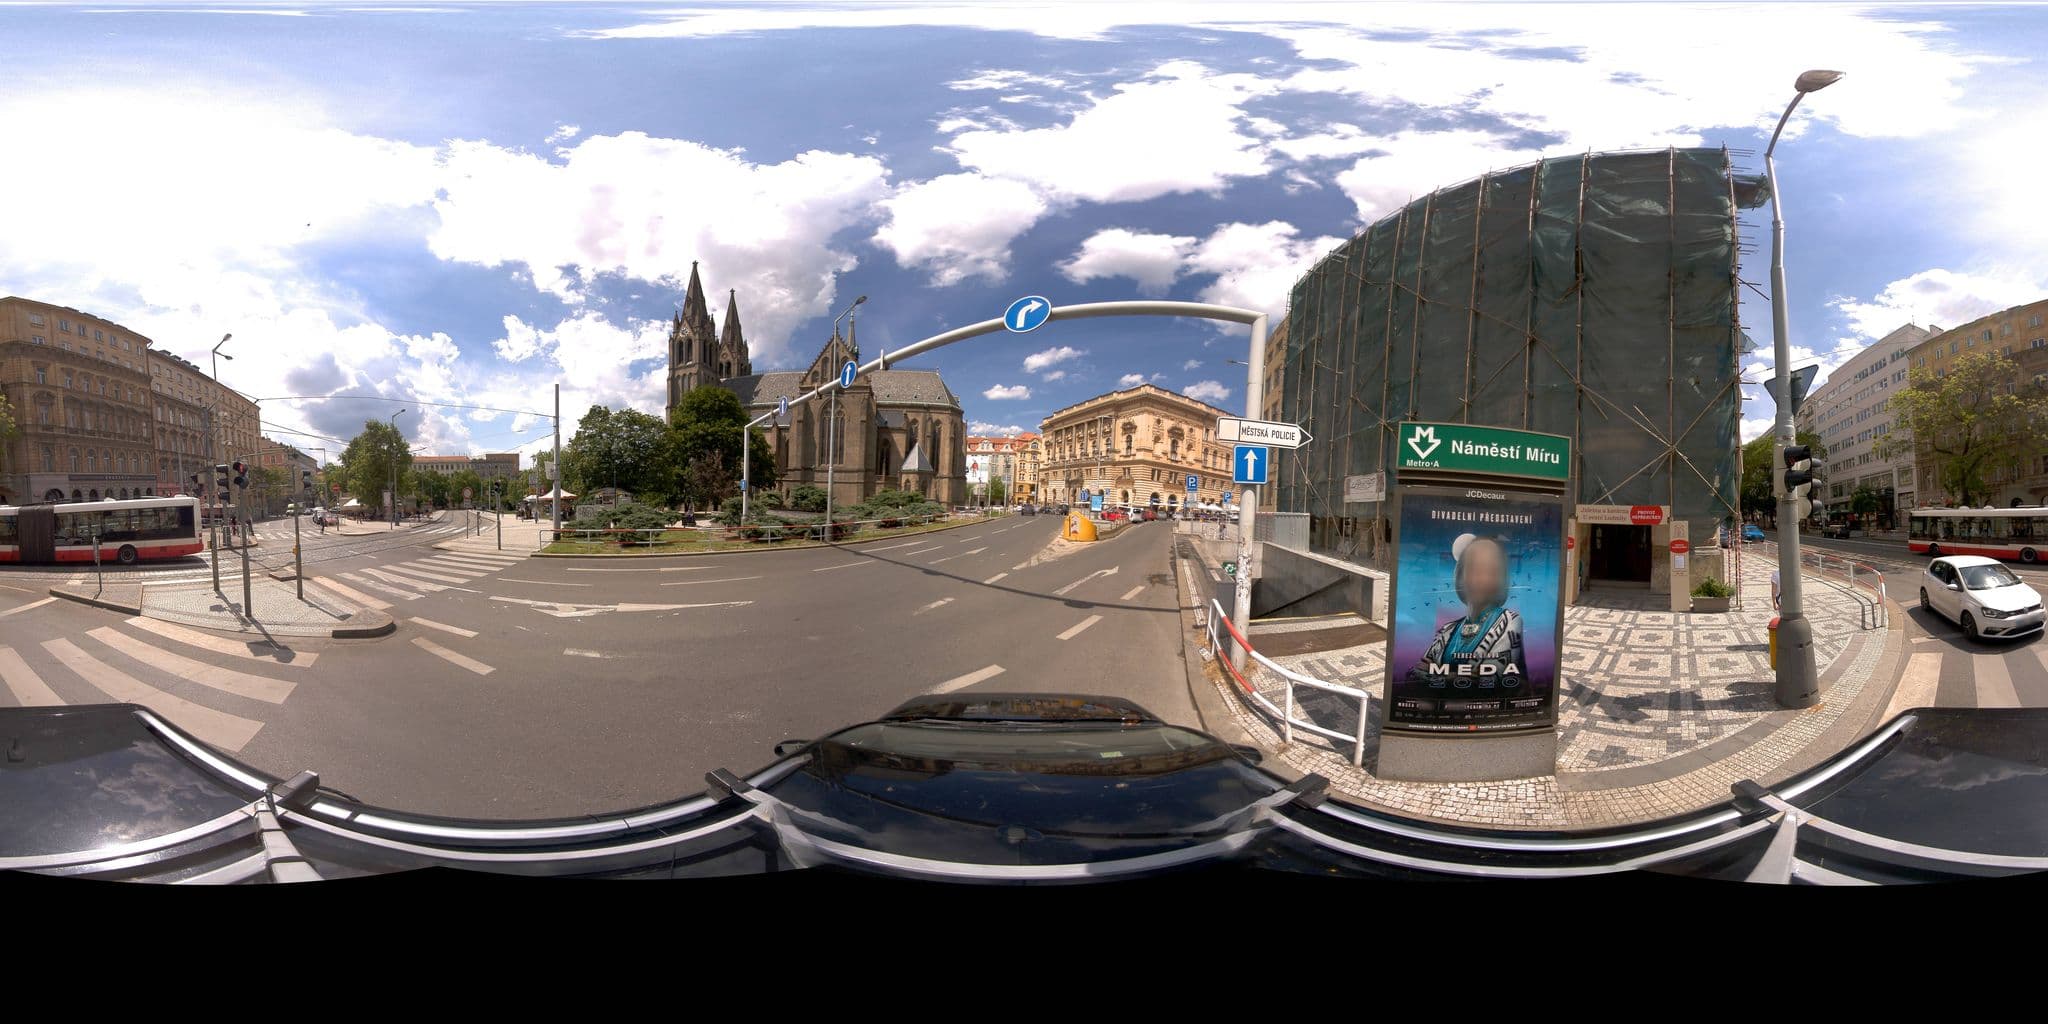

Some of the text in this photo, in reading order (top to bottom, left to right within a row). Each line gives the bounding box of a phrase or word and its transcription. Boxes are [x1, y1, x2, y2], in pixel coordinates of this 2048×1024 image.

[1241, 426, 1296, 441] MĚSTSKÁ POLICIE
[1451, 439, 1560, 464] Náměstí Míru
[1465, 490, 1505, 500] JCDecaux
[1431, 510, 1532, 524] DIVADELNÍ PŘEDSTAVENÍ
[1429, 663, 1520, 675] MEDA
